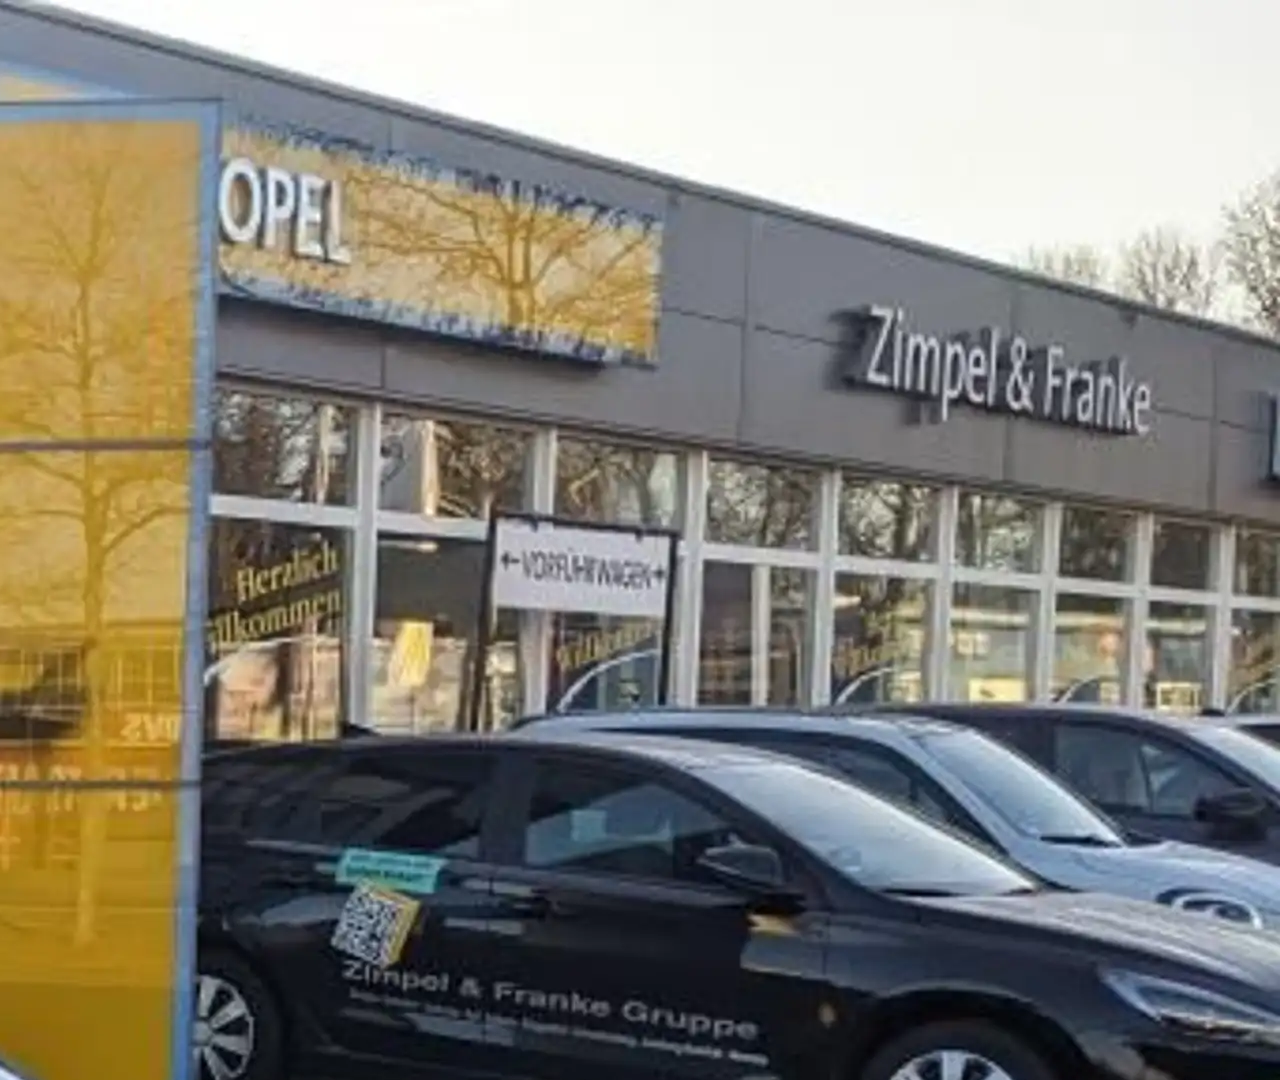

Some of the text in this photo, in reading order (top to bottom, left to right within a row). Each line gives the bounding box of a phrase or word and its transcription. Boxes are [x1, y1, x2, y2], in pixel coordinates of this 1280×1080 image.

[218, 157, 352, 264] OPEL
[866, 303, 1151, 433] Zimpel & Franke
[237, 539, 338, 604] Herzlich
[459, 977, 482, 998] &
[494, 981, 611, 1018] Franke
[622, 1000, 759, 1041] Gruppe
